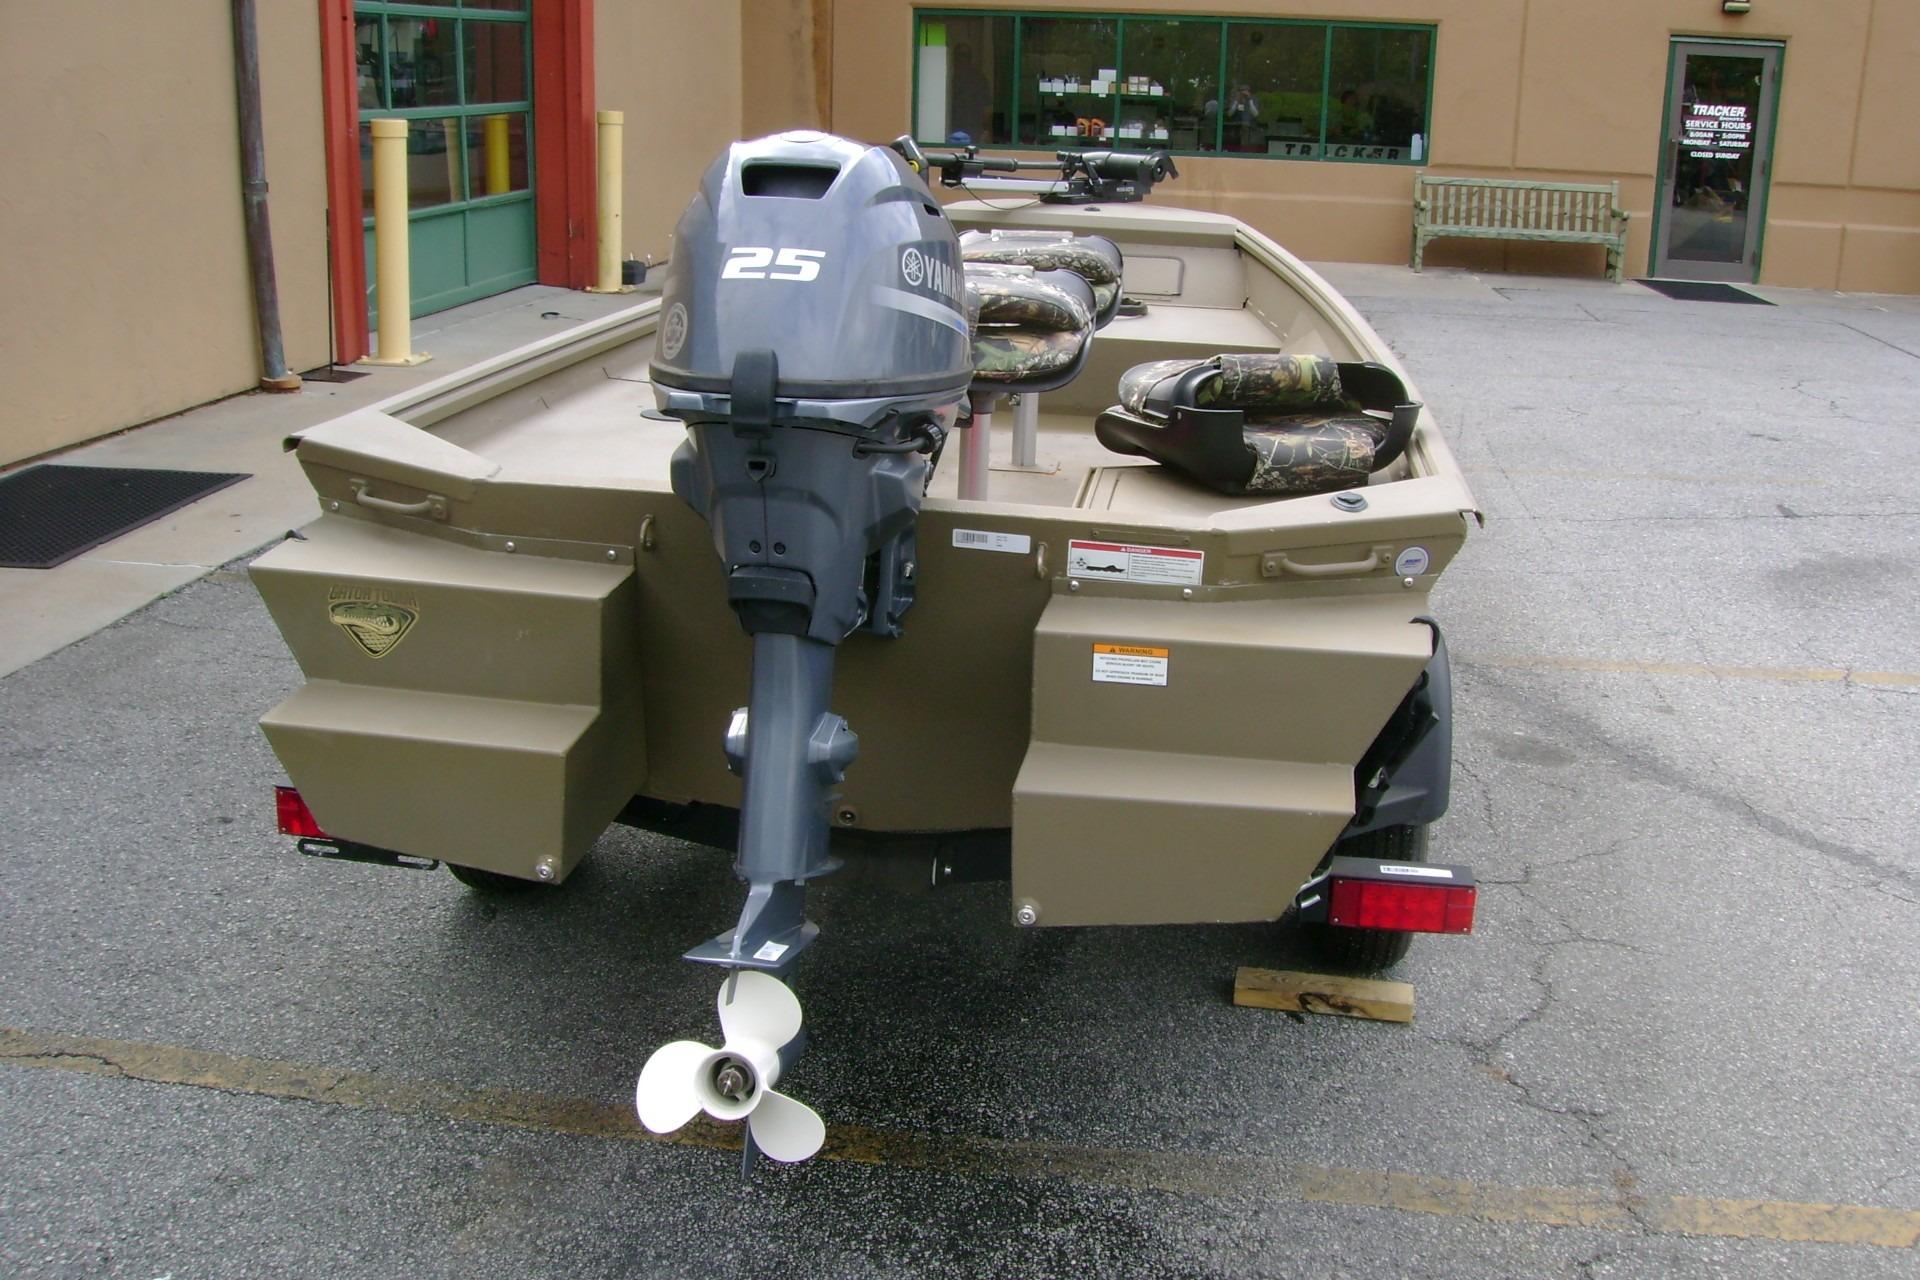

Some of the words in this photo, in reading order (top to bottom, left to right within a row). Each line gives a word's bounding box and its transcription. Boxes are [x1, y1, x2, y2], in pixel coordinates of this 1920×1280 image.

[1693, 104, 1746, 116] TRACKER
[1685, 120, 1719, 128] SERVICE
[1721, 122, 1751, 130] HOURS
[721, 246, 826, 282] 25
[1118, 647, 1153, 655] WARNING
